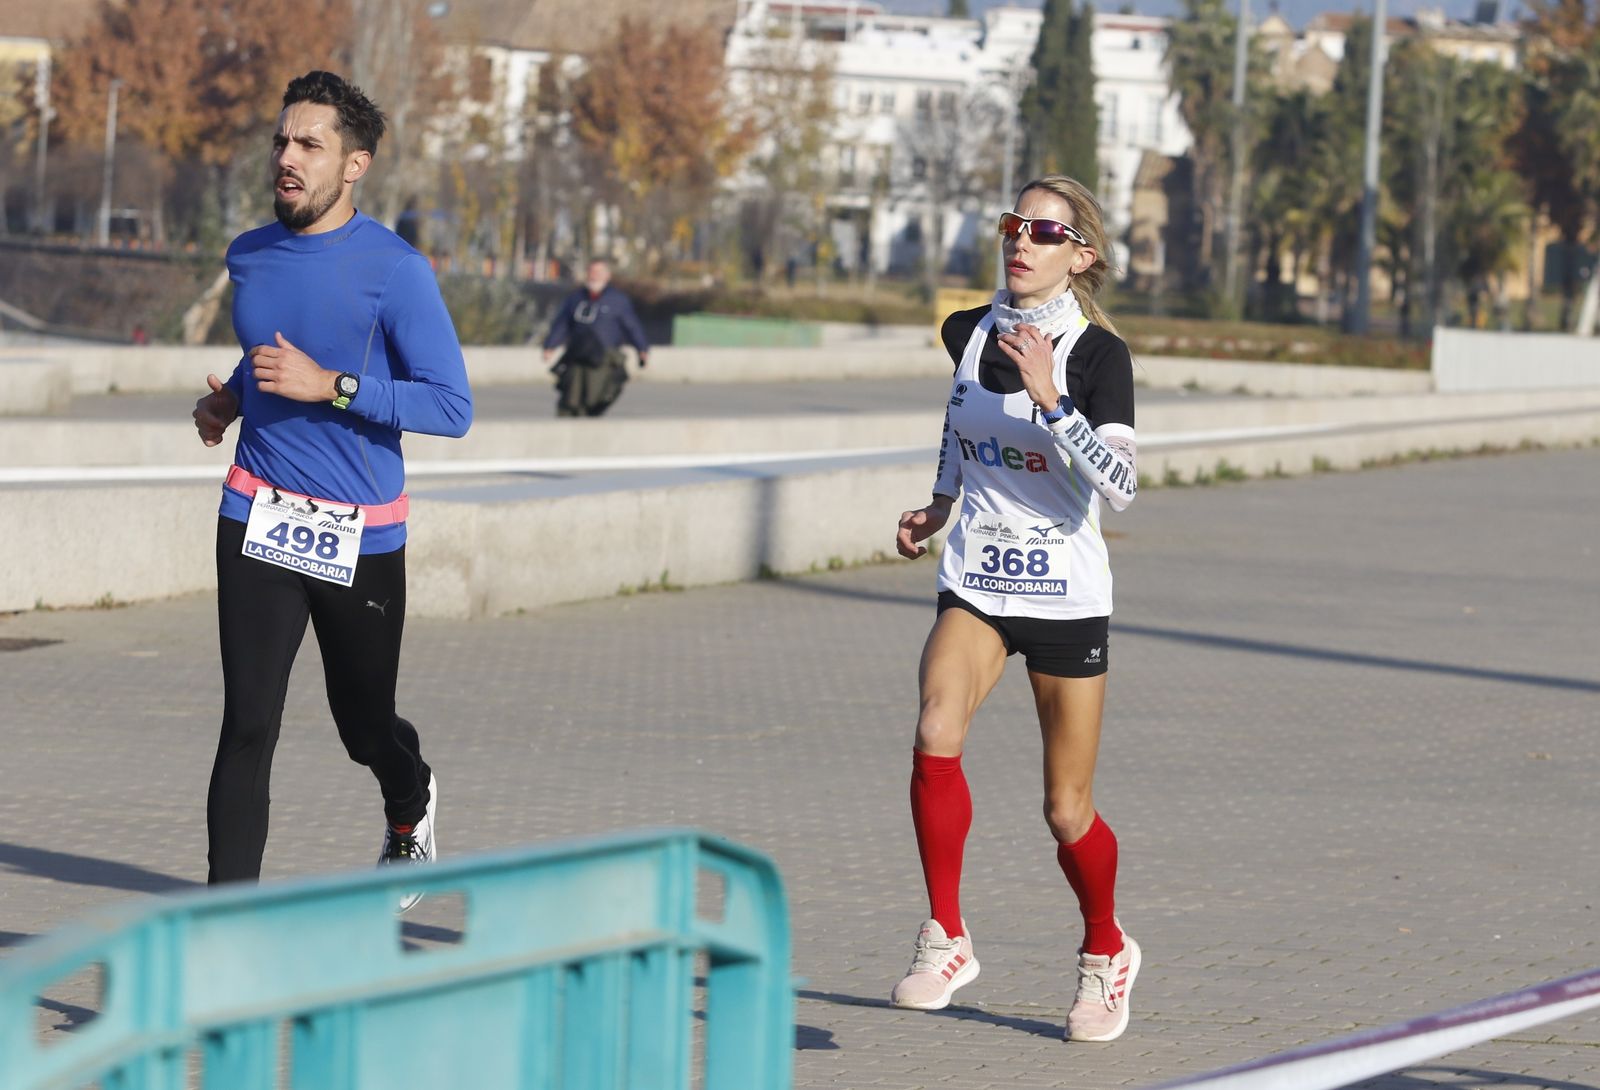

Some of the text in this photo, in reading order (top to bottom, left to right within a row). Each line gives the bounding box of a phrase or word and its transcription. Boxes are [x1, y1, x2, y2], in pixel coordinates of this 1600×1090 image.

[1065, 420, 1113, 474] NEVER
[266, 521, 340, 561] 498
[247, 543, 348, 581] LA CORDOBARIA
[981, 544, 1050, 577] 368
[965, 575, 1065, 594] LA CORDOBARIA
